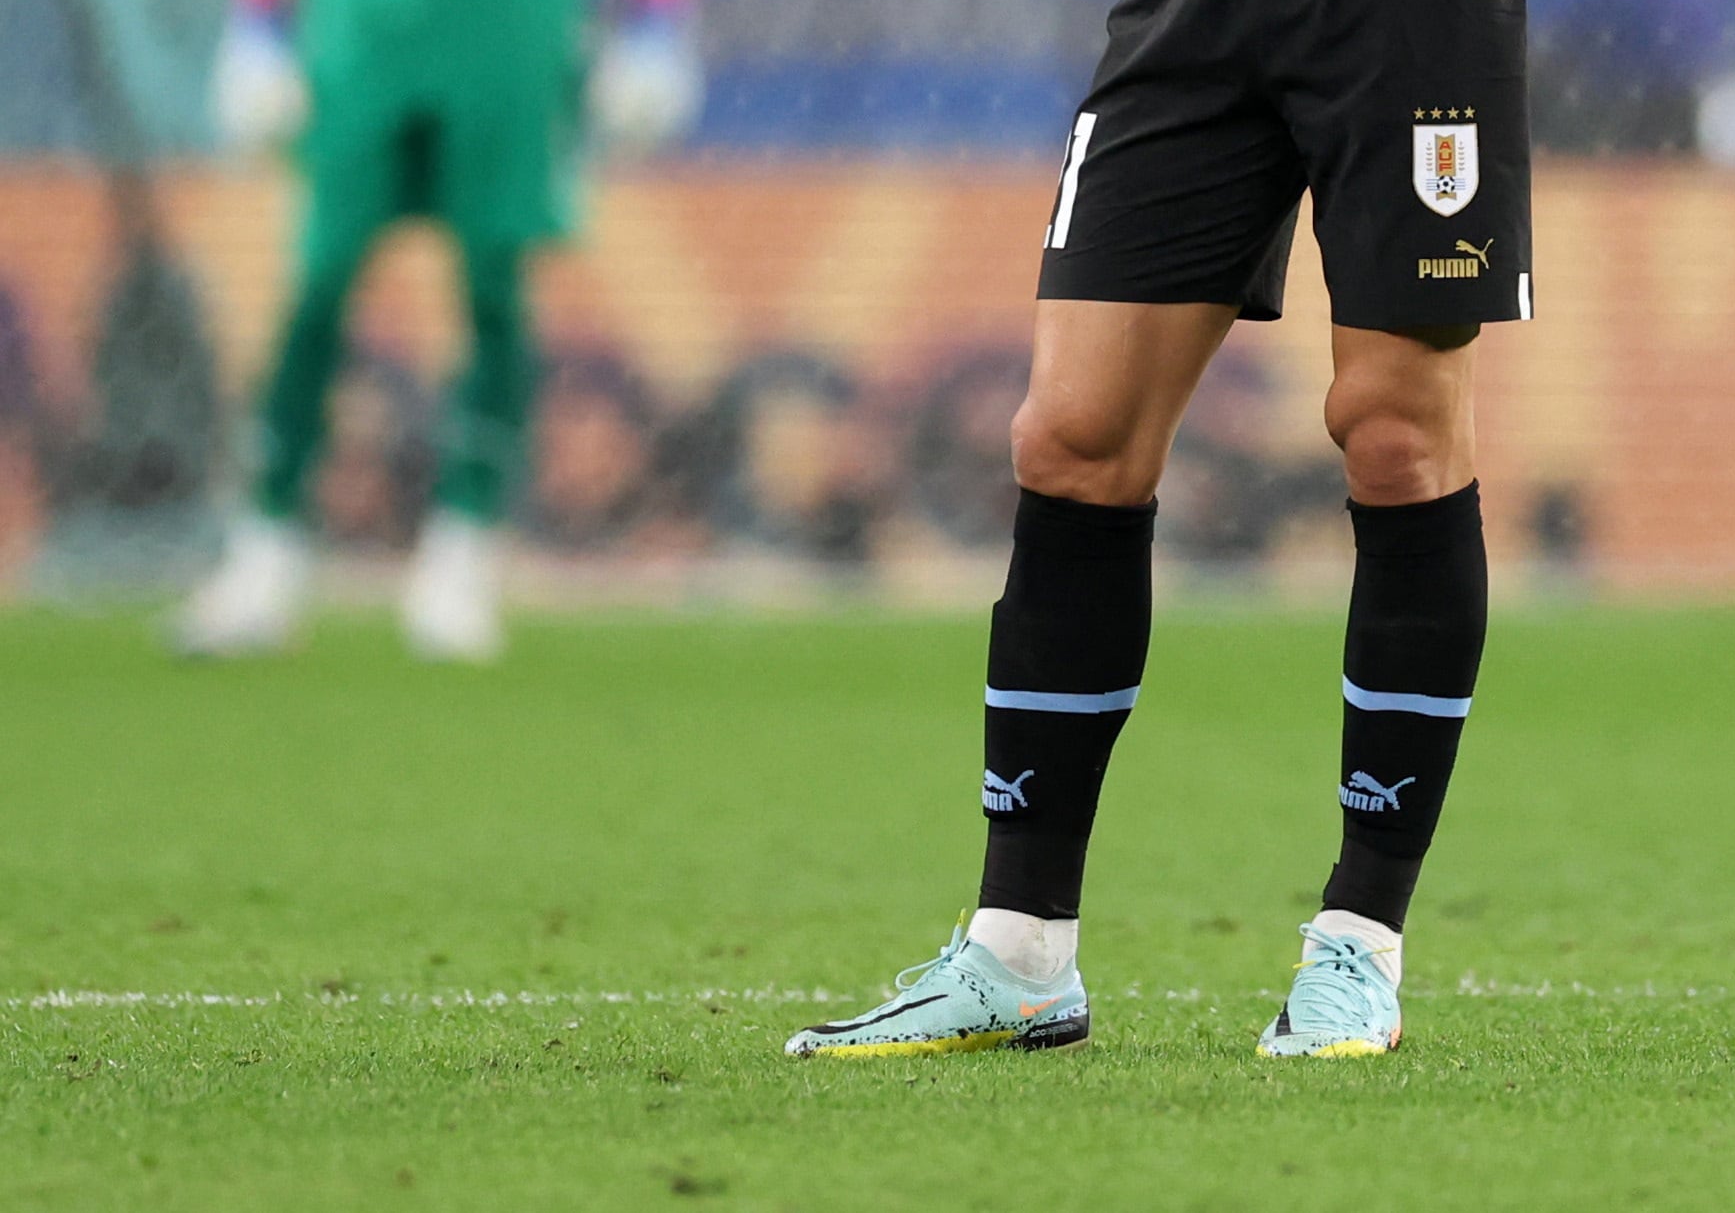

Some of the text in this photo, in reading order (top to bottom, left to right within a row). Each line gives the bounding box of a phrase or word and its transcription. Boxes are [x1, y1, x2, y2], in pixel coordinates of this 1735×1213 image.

[1438, 140, 1453, 172] AUF
[1418, 258, 1479, 279] PUMA
[1338, 783, 1385, 812] UMA
